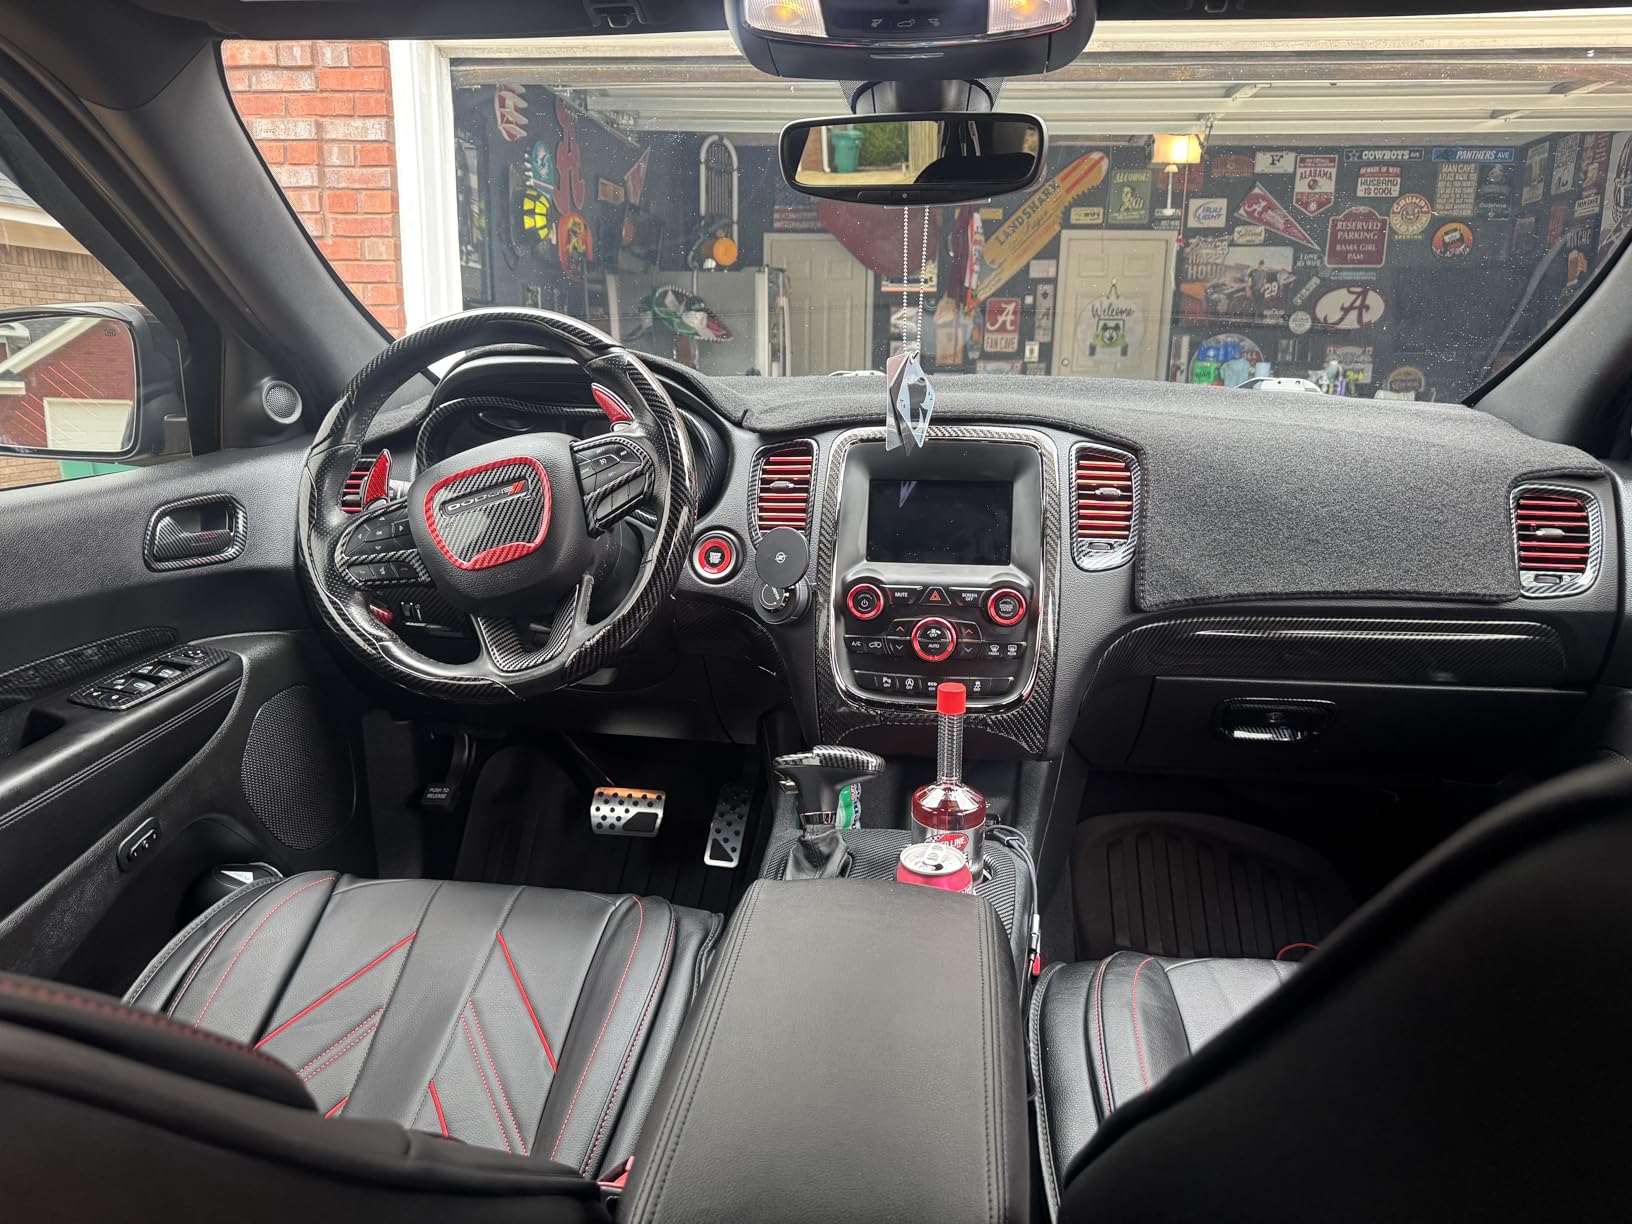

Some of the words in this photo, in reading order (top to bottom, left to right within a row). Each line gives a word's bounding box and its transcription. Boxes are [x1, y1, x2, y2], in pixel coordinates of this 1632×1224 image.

[1362, 150, 1410, 160] COWBOYS
[1455, 150, 1496, 160] PANTHERS
[1497, 151, 1510, 159] AVE
[1442, 163, 1458, 173] MAN
[1458, 163, 1475, 173] CAVE
[1299, 169, 1333, 181] ALABAMA
[1360, 178, 1398, 187] HUSBAND
[1363, 187, 1371, 195] IS
[1373, 187, 1393, 196] COOL
[997, 180, 1061, 246] LANDSHARK
[1336, 221, 1380, 231] RESERVED
[1337, 231, 1378, 240] PARKING
[1336, 243, 1358, 251] BAMA
[1359, 243, 1377, 251] GIRL
[1347, 252, 1364, 260] PAM
[1264, 283, 1278, 298] 29
[1091, 301, 1136, 319] Welcome
[986, 302, 1017, 331] A
[986, 337, 999, 349] FAN
[1001, 337, 1017, 349] CAVE
[950, 836, 966, 847] LINE
